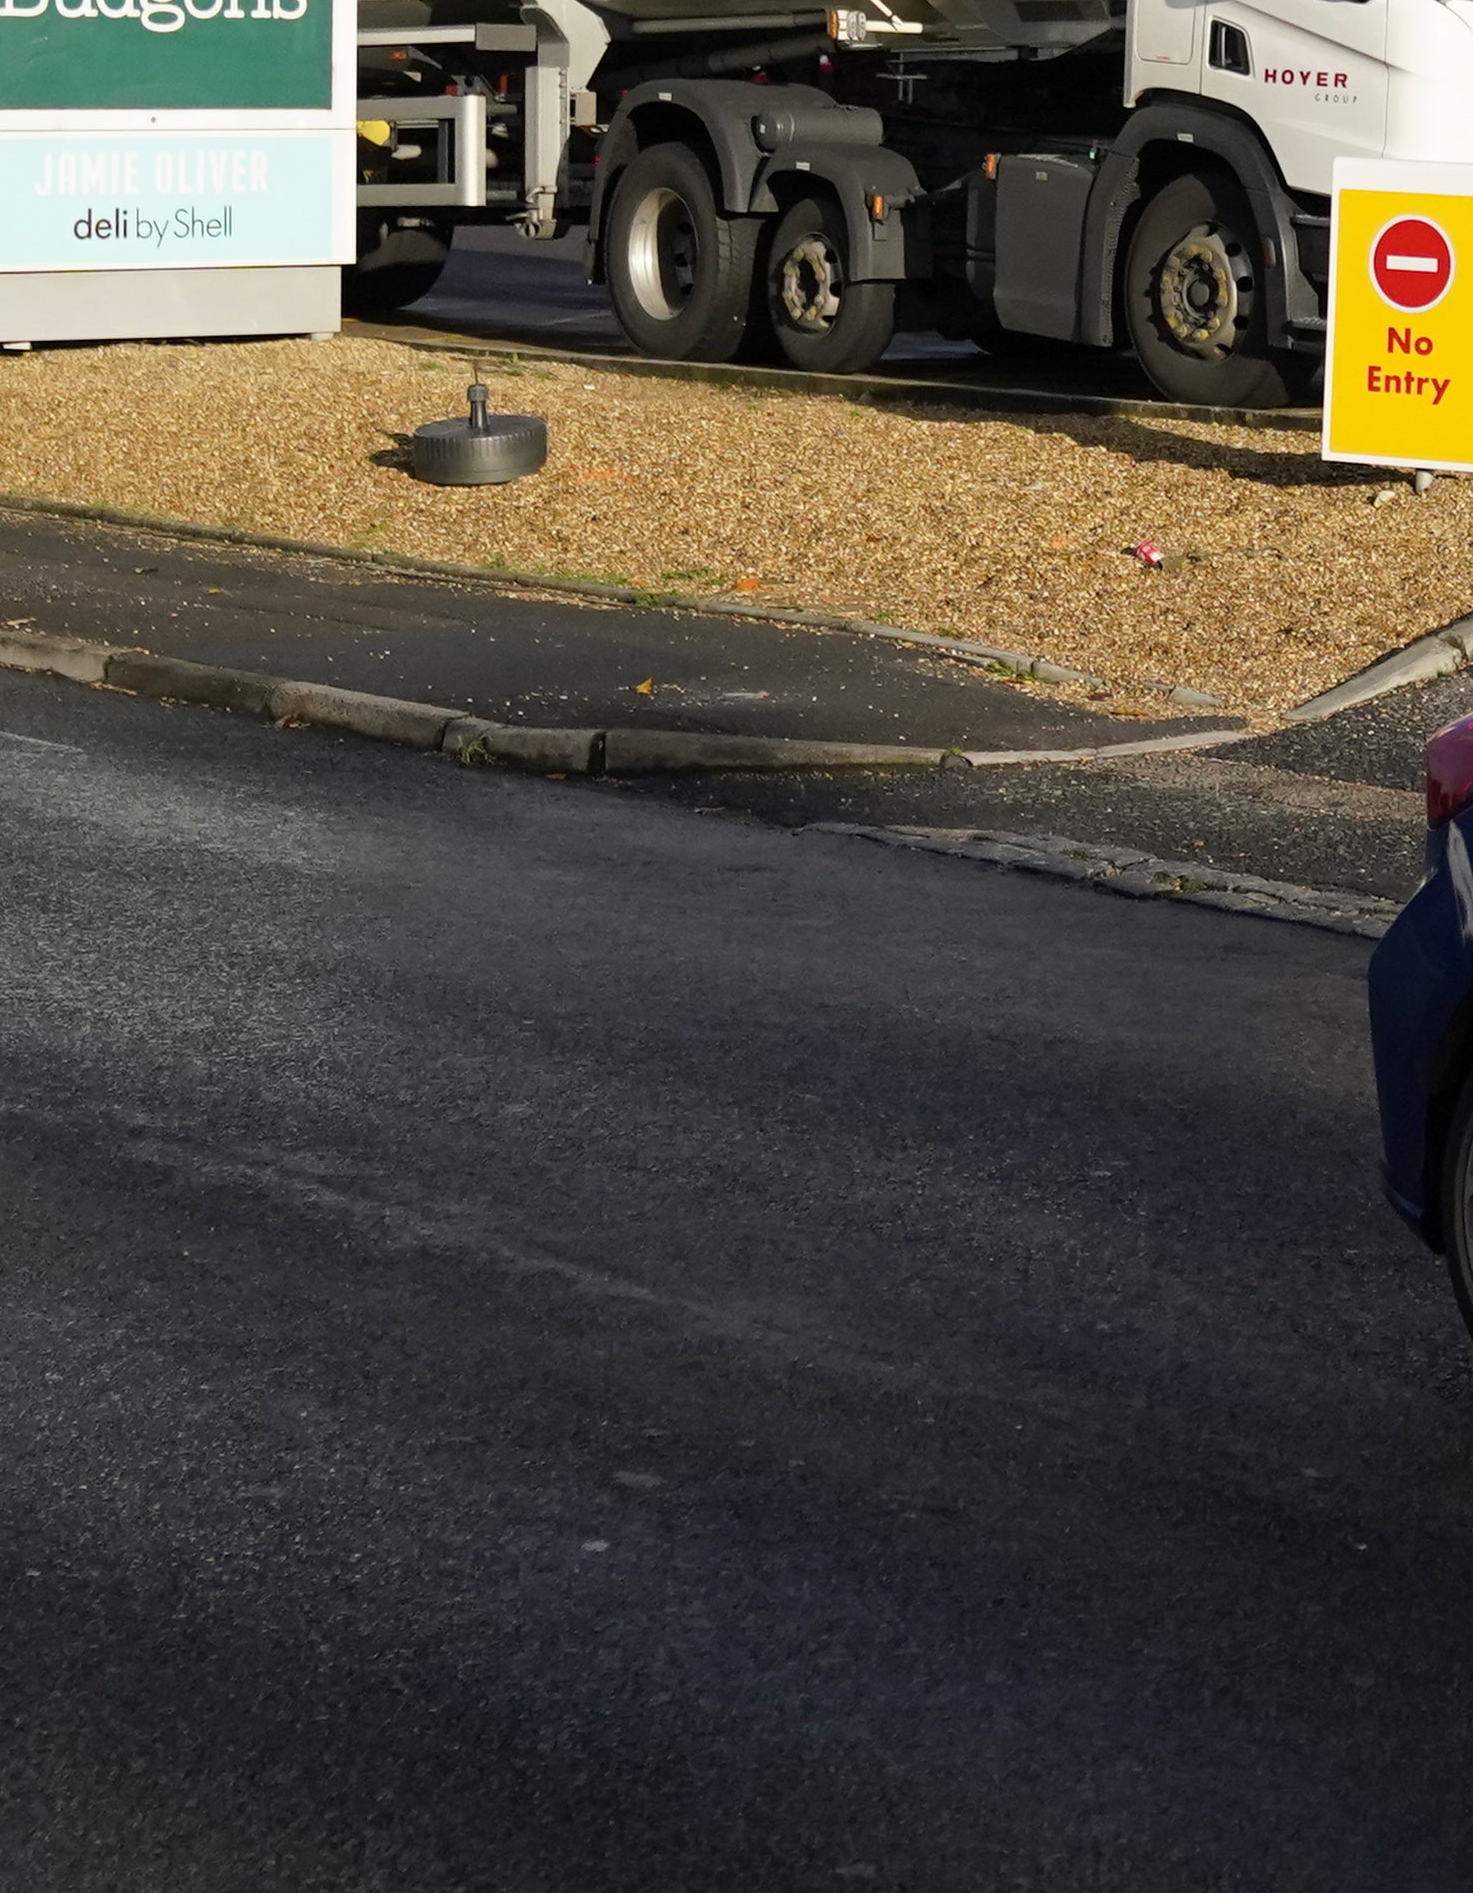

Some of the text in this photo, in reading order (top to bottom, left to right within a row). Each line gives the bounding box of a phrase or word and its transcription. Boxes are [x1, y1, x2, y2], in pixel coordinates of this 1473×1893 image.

[1264, 68, 1349, 89] HOYER
[1314, 93, 1358, 105] GROUP
[35, 149, 270, 198] JAMIE OLIVER
[73, 206, 233, 247] deli by Shell
[1387, 327, 1434, 356] No
[1367, 365, 1452, 406] Entry
